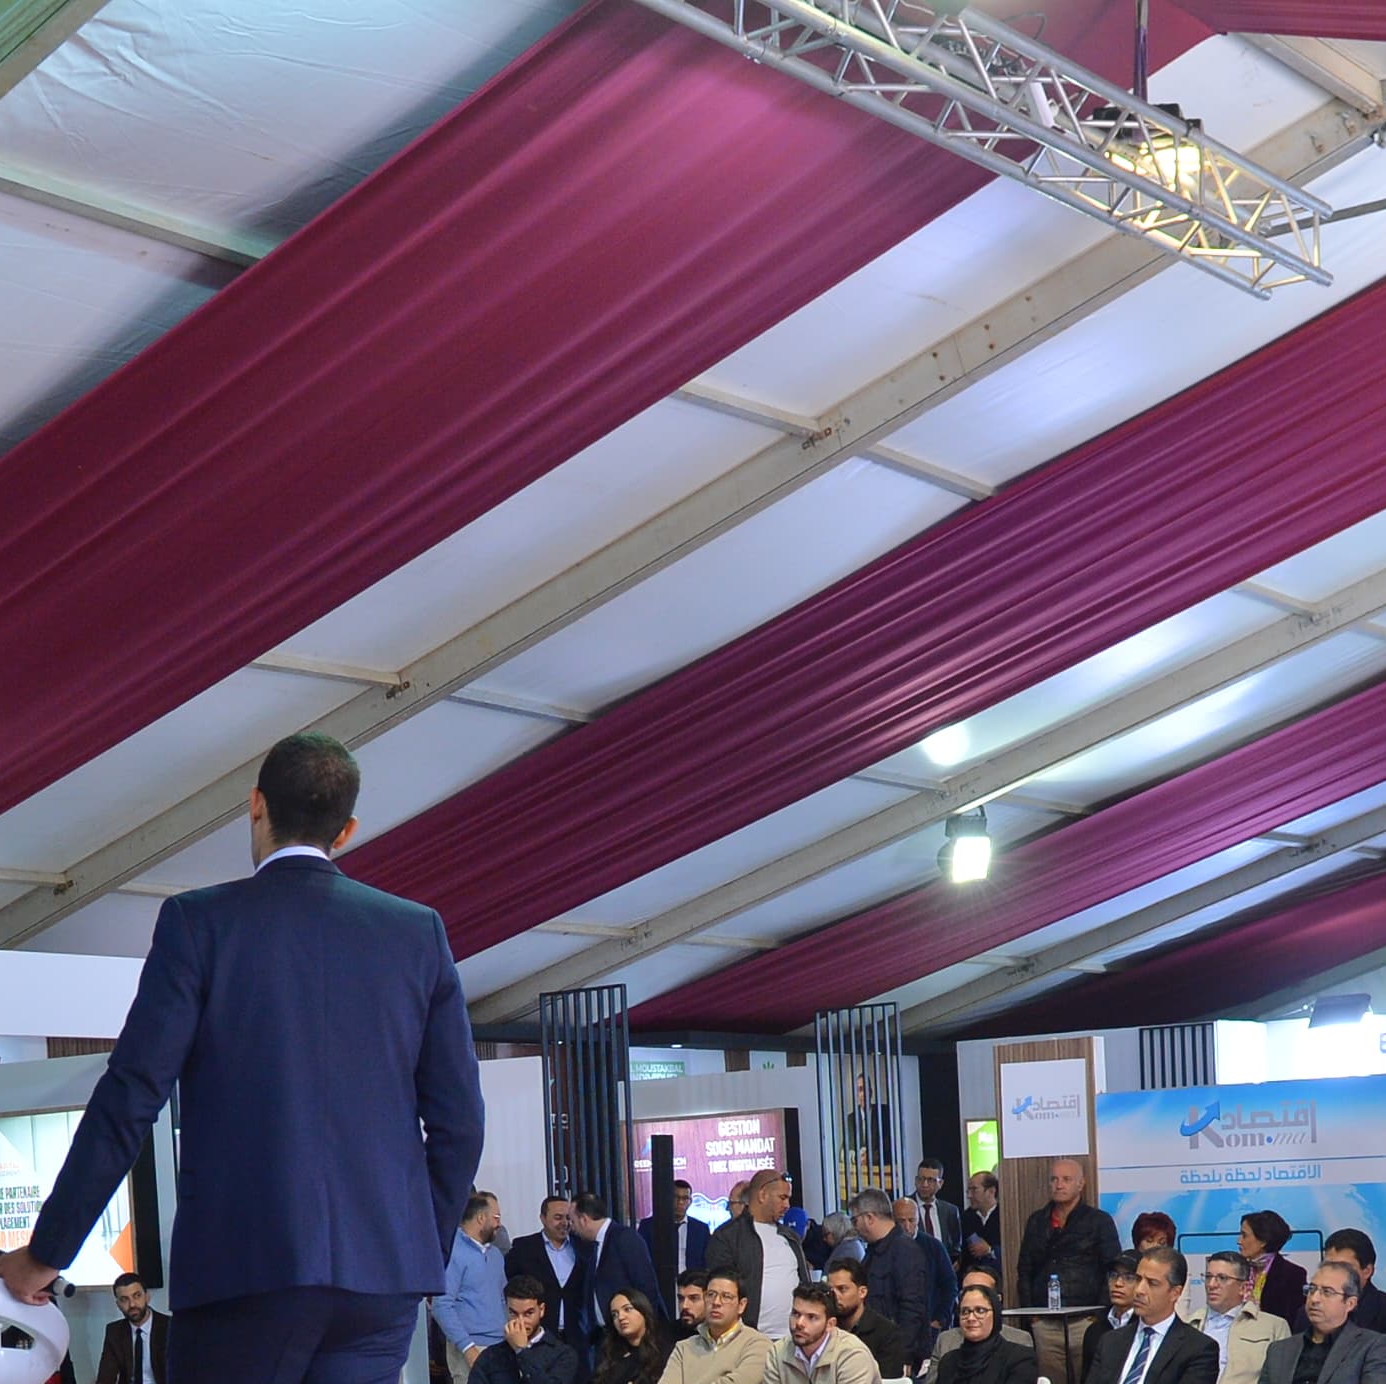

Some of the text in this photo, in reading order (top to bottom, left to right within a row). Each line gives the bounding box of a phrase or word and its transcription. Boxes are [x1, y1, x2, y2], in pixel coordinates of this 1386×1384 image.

[1032, 1094, 1080, 1118] اقتصاد
[718, 1118, 760, 1137] GESTION
[1220, 1098, 1318, 1143] اقتصاد
[706, 1137, 776, 1157] SOUS MANDAT
[1180, 1164, 1322, 1186] الاقتصاد لحظة بلحظة
[6, 1186, 40, 1199] PARTENAIRE
[4, 1202, 15, 1214] DES
